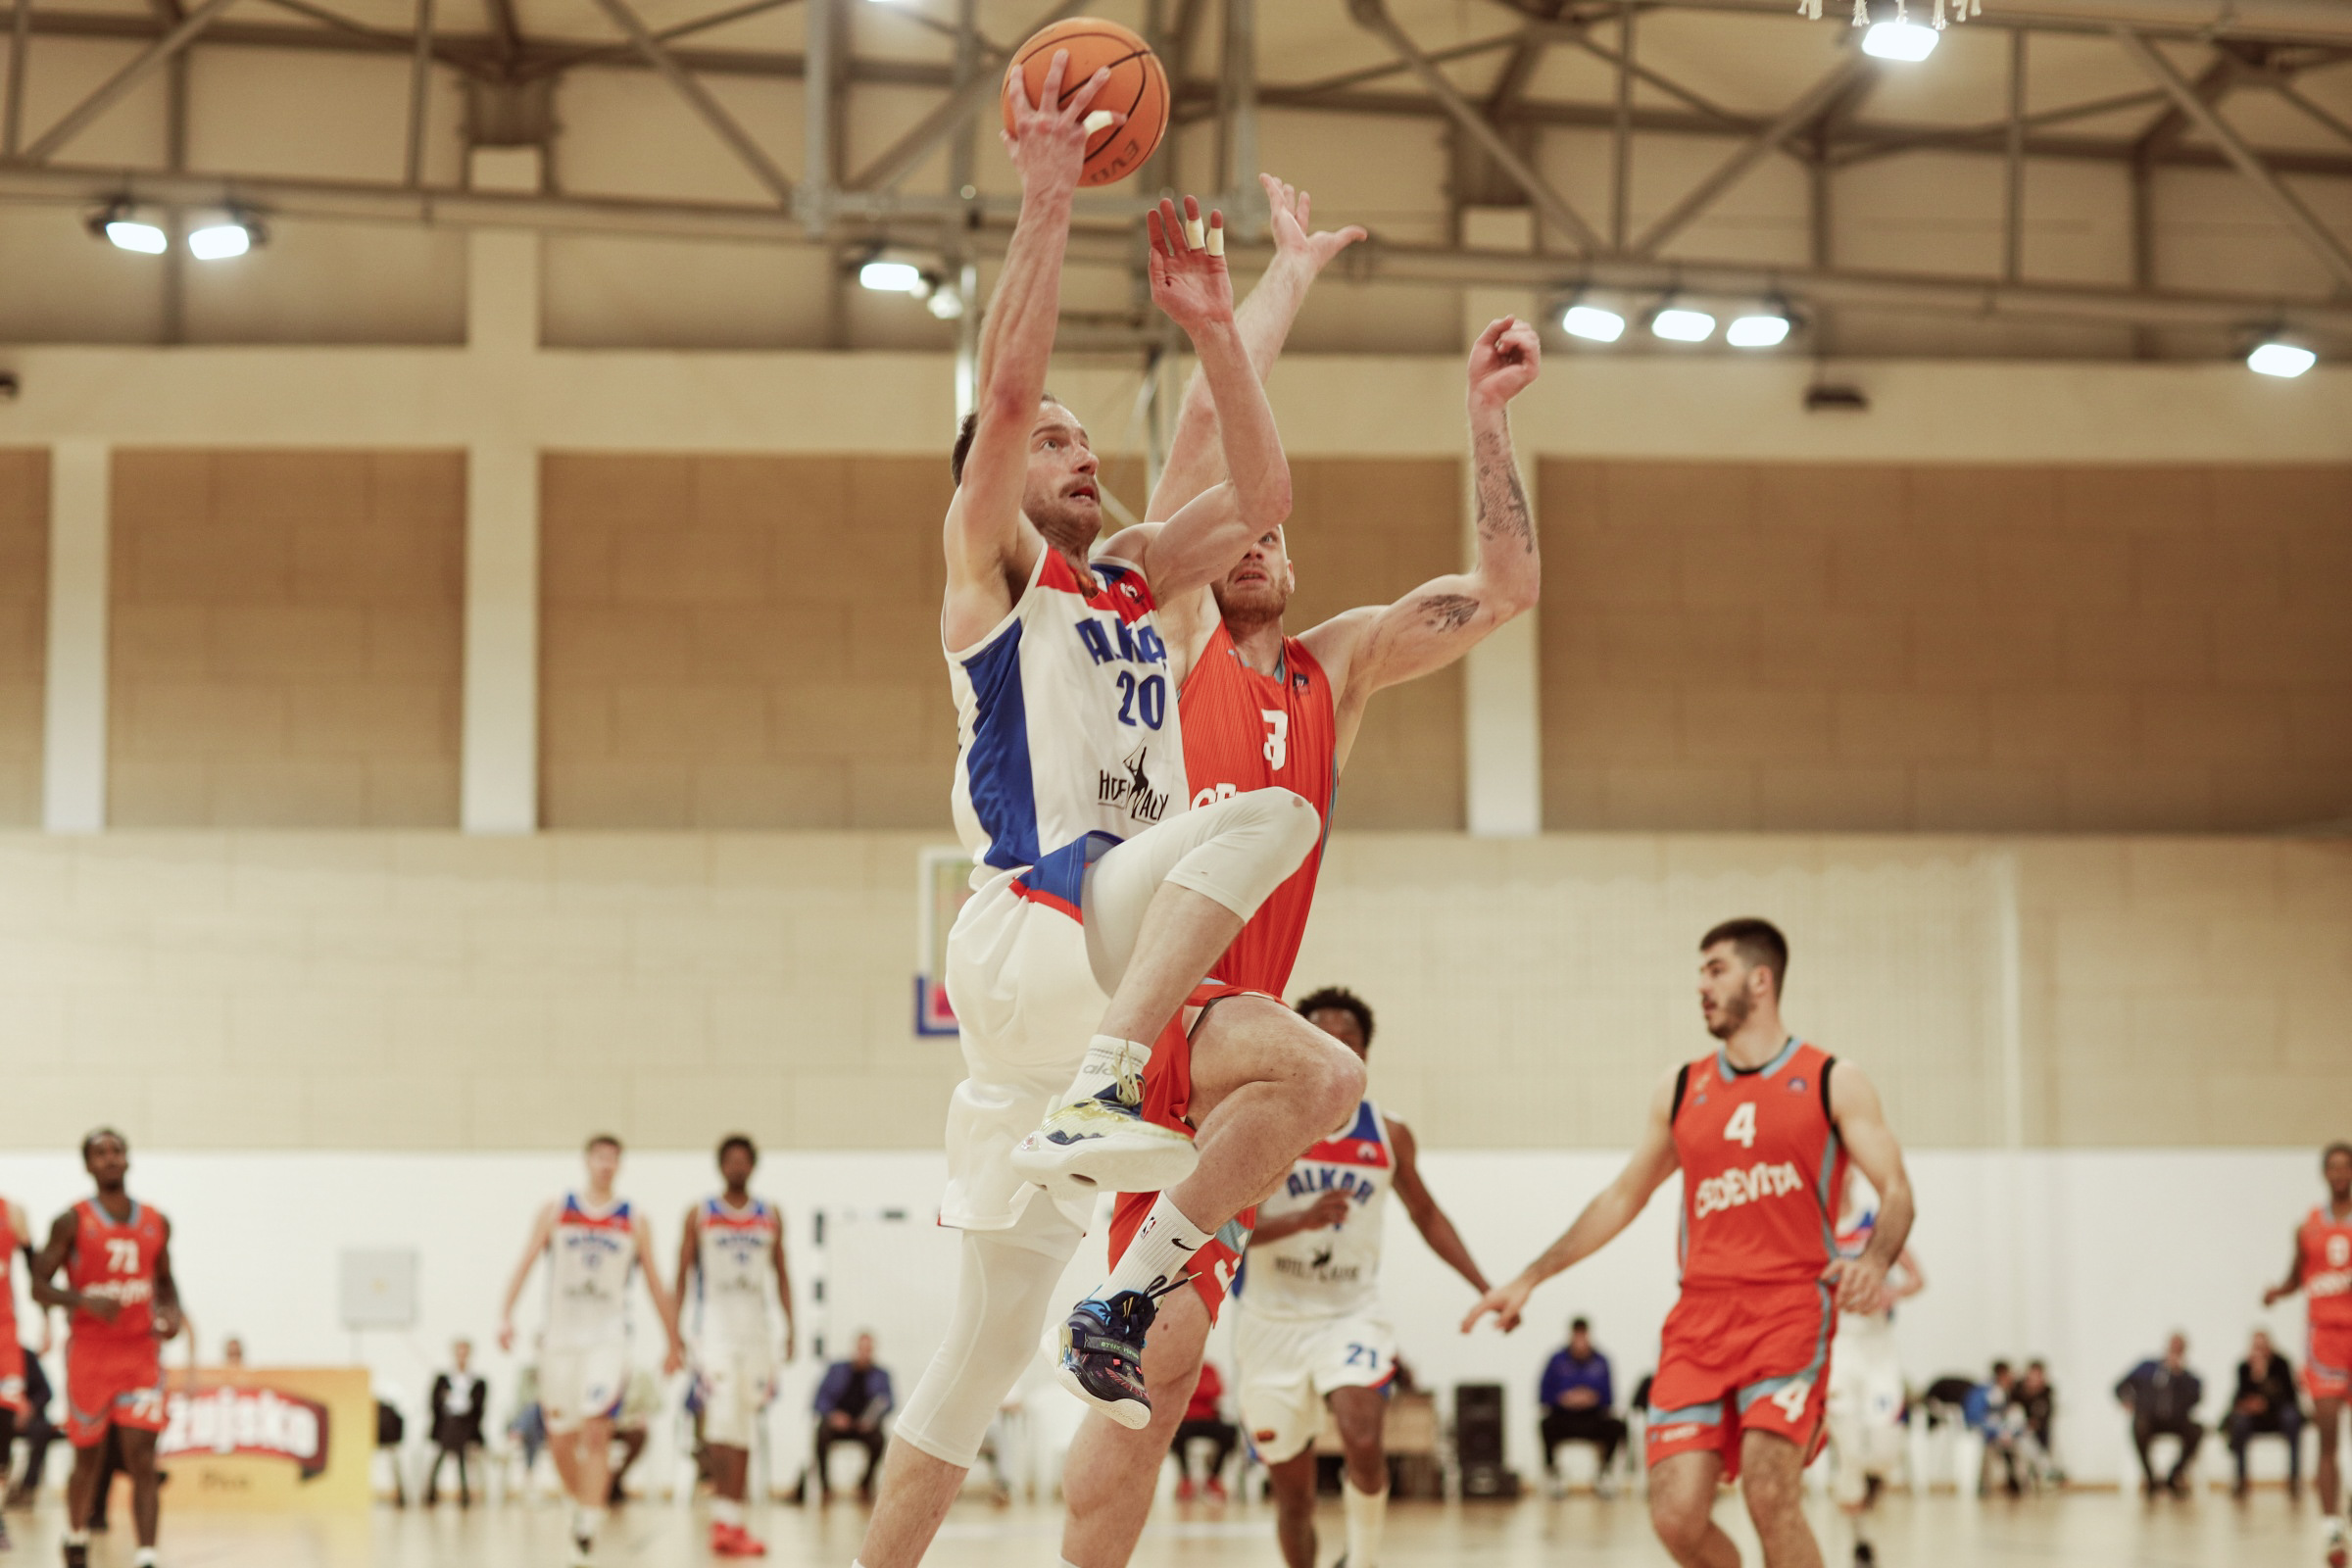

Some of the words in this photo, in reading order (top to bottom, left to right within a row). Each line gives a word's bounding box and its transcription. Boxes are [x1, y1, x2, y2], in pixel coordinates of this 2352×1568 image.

[1116, 669, 1166, 731] 20
[1261, 709, 1289, 771] 3
[1724, 1102, 1757, 1149] 4
[1346, 1343, 1378, 1369] 21
[1771, 1378, 1813, 1423] 4
